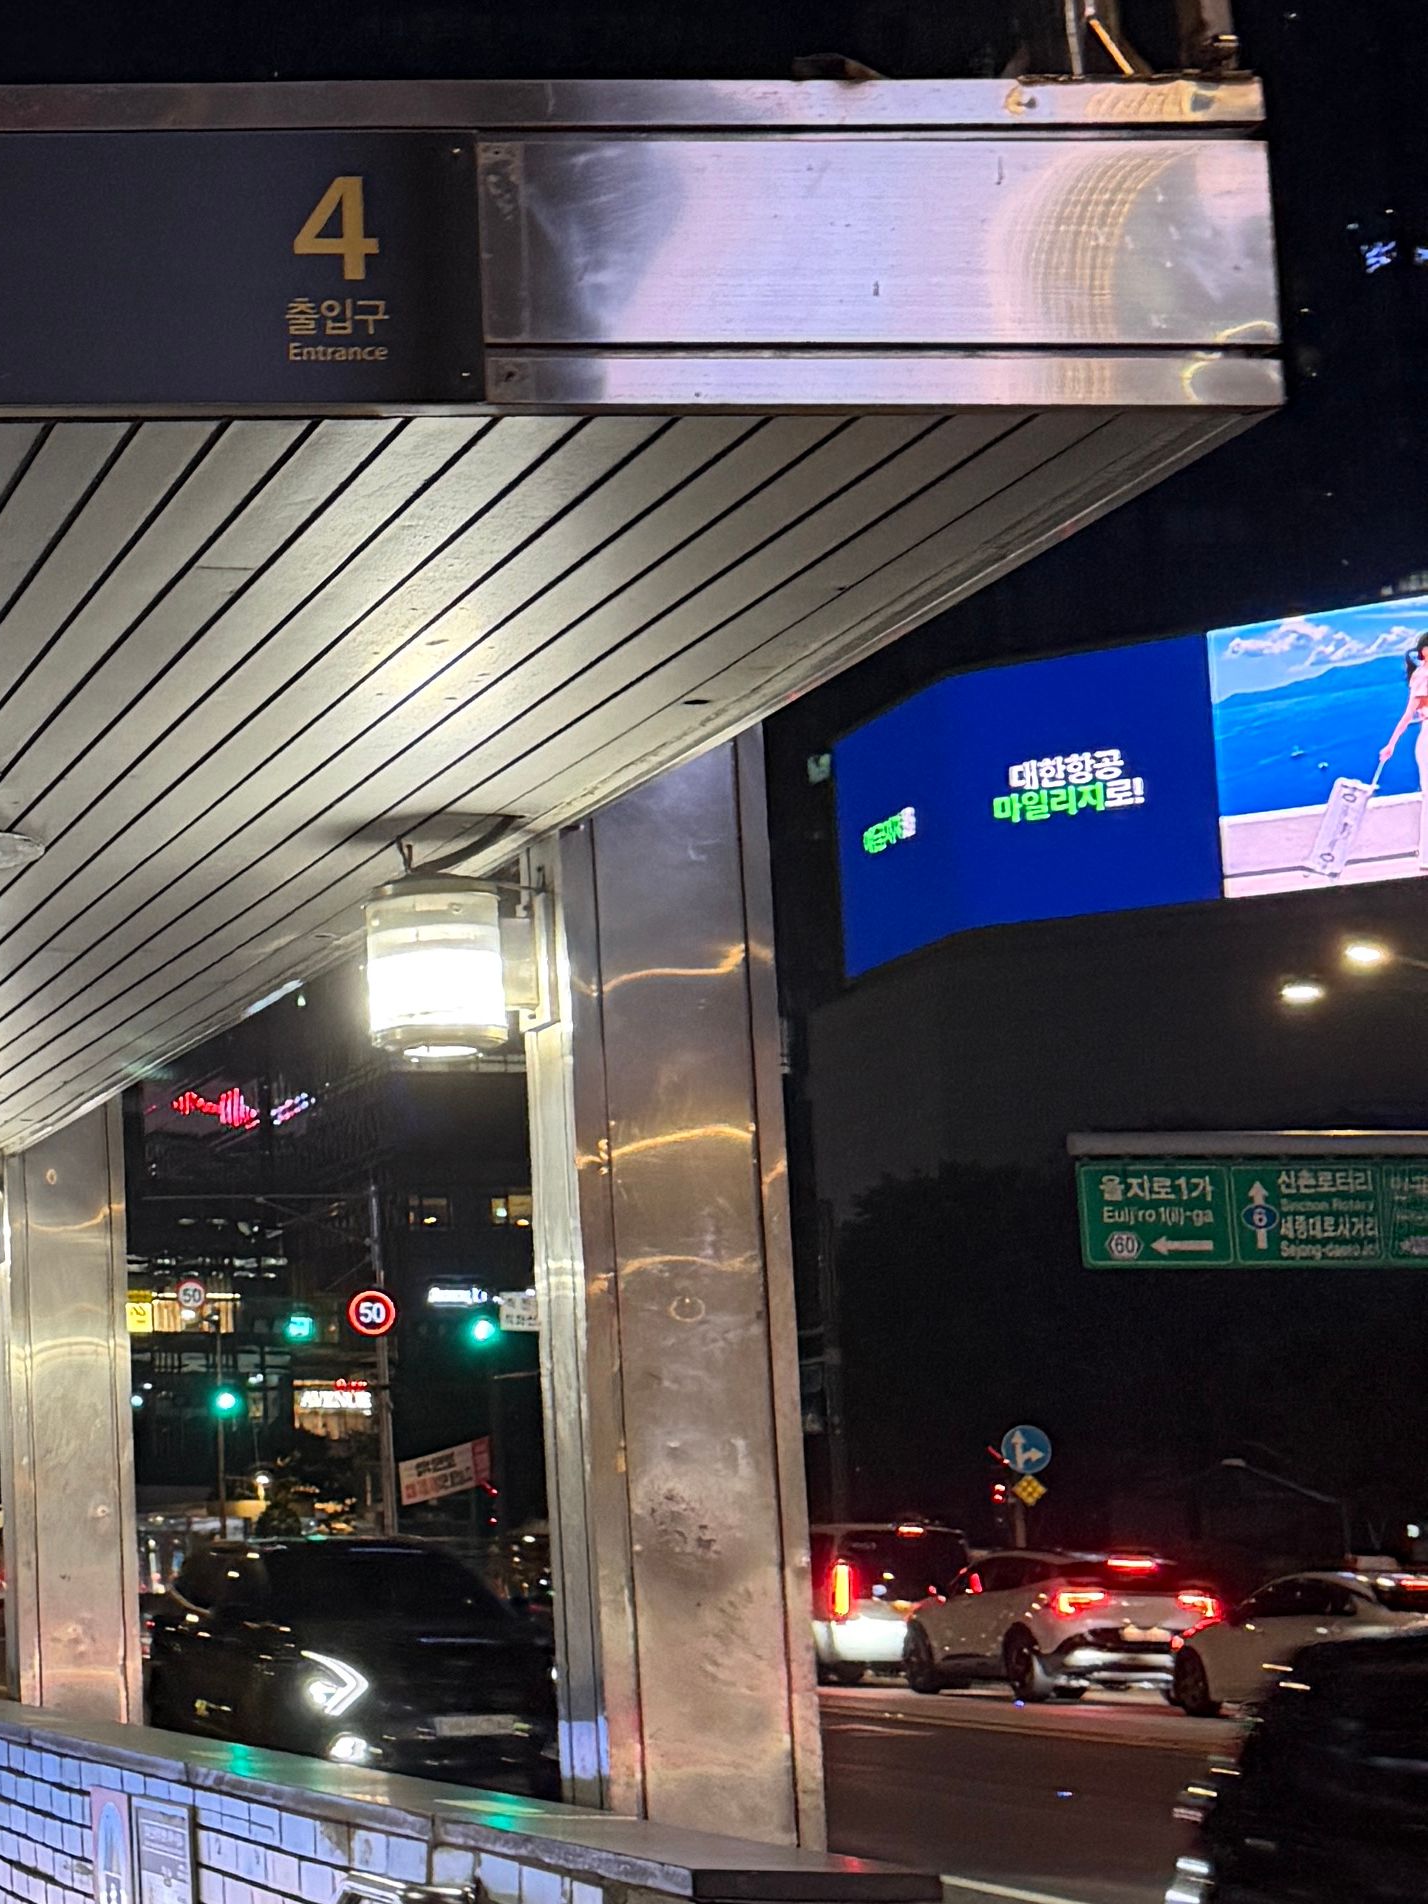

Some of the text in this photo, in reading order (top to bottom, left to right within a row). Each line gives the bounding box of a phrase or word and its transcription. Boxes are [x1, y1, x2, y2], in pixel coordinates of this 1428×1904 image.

[293, 176, 379, 280] 4
[285, 297, 390, 335] 출입구
[288, 342, 388, 361] Entrance
[1008, 749, 1124, 789] 대한항공
[1099, 1175, 1213, 1201] 을지로1가
[1253, 1208, 1267, 1227] 6
[359, 1302, 386, 1324] 50
